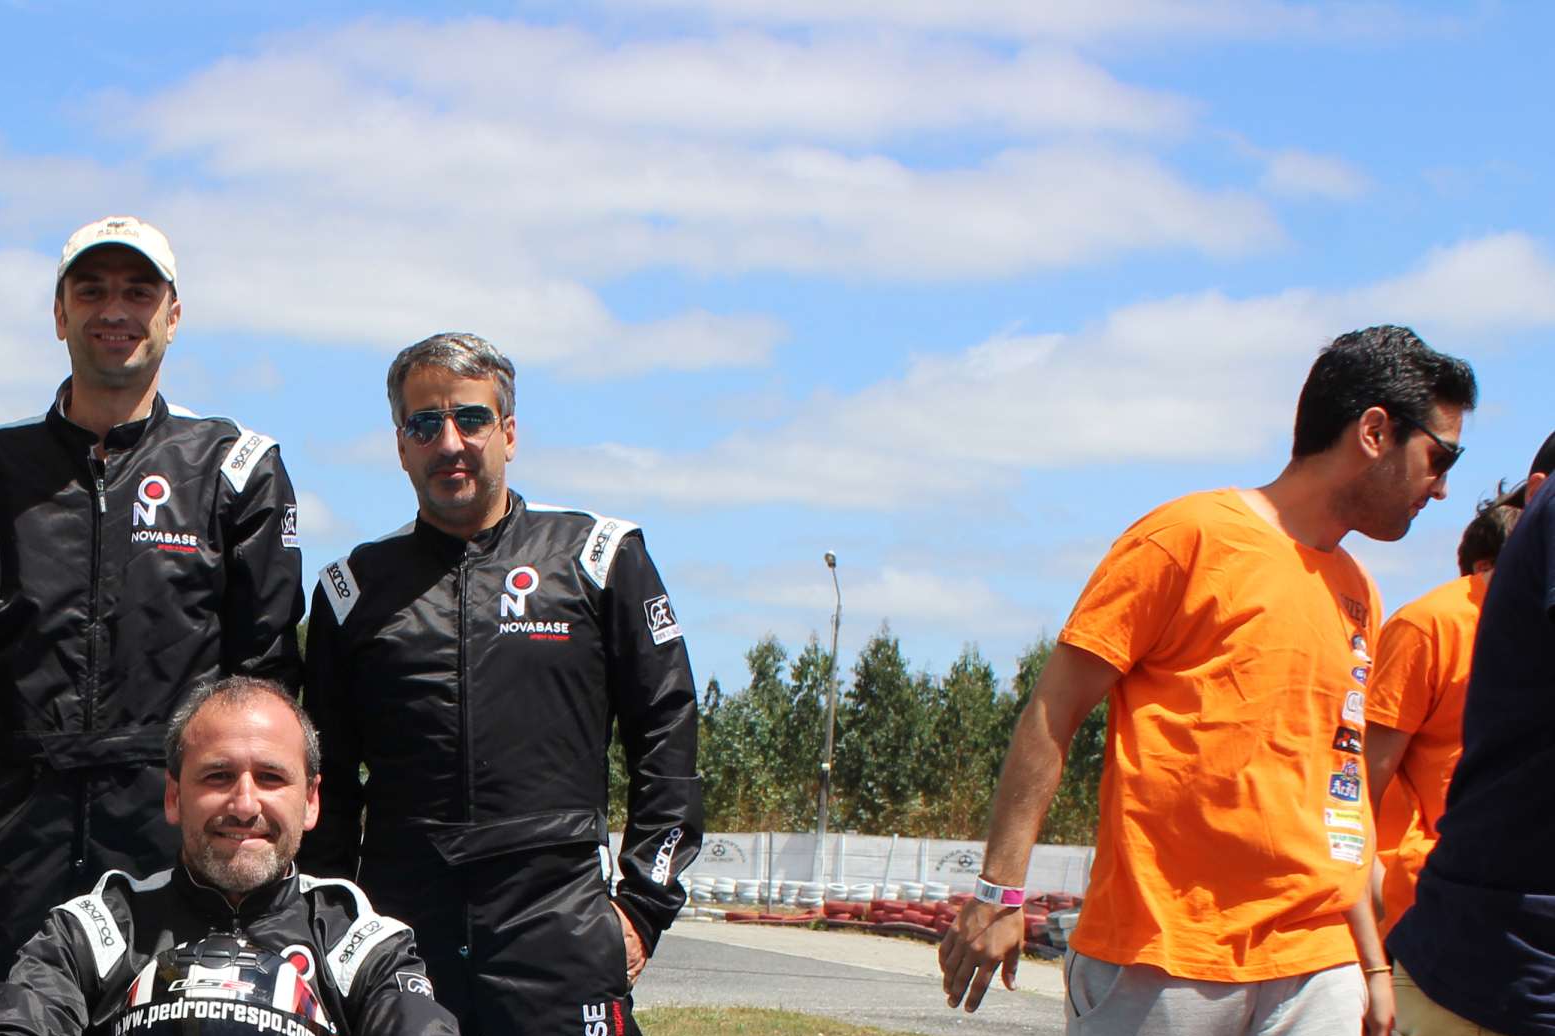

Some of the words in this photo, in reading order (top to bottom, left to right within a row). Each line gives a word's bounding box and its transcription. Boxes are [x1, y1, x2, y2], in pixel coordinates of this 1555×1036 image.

[131, 529, 198, 546] NOVABASE
[499, 621, 570, 634] NOVABASE
[76, 899, 115, 948] sparco
[338, 920, 385, 965] sparco
